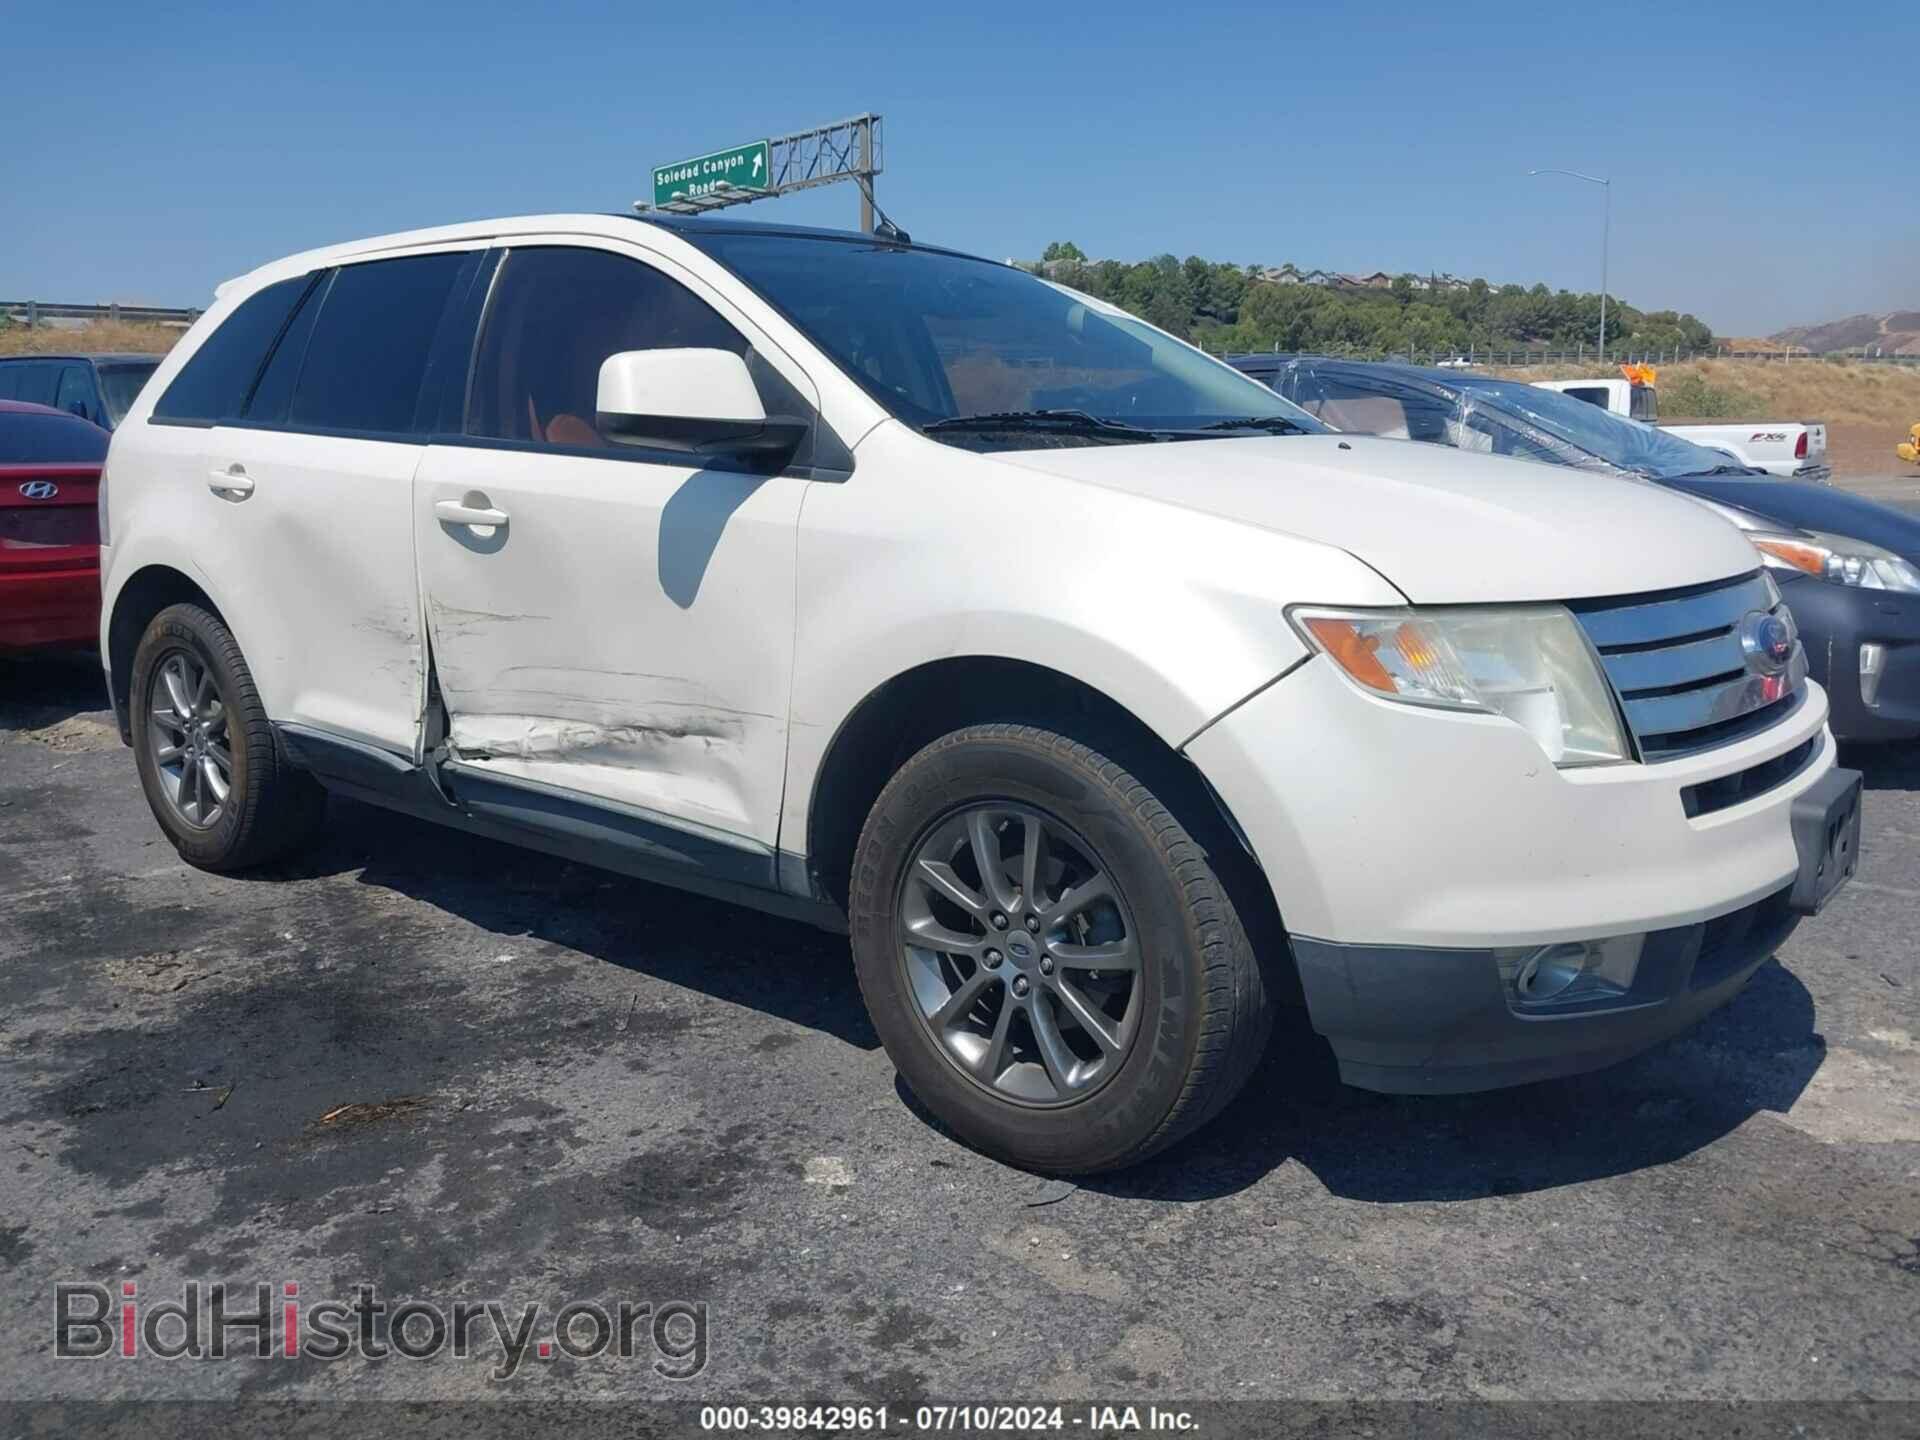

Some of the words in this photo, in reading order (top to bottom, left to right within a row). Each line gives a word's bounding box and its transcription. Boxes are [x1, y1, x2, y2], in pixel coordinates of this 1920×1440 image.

[657, 164, 699, 186] Soledad
[703, 154, 744, 174] Canyon
[689, 179, 716, 196] Road
